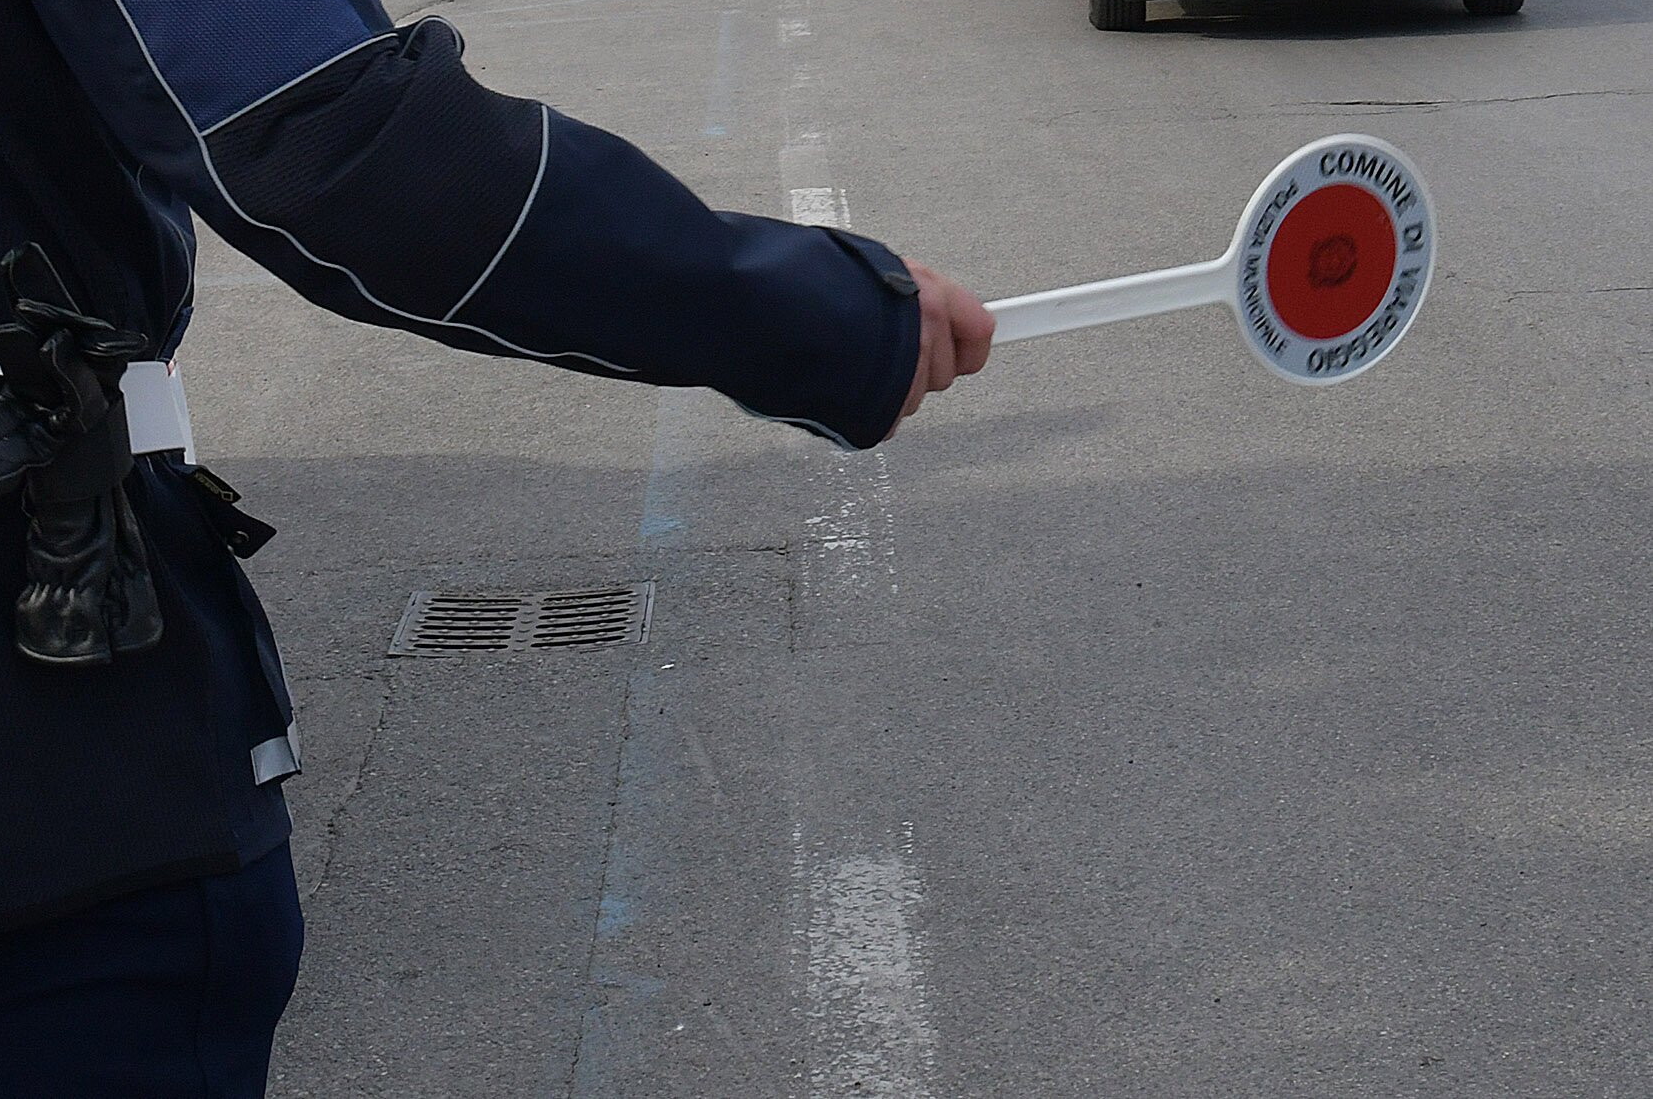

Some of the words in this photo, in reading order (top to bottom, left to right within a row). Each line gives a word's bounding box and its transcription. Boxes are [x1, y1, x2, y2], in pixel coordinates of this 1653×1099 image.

[1320, 149, 1417, 218] COMUNE
[1403, 221, 1424, 254] DI
[1243, 253, 1289, 358] MUNICIPALE
